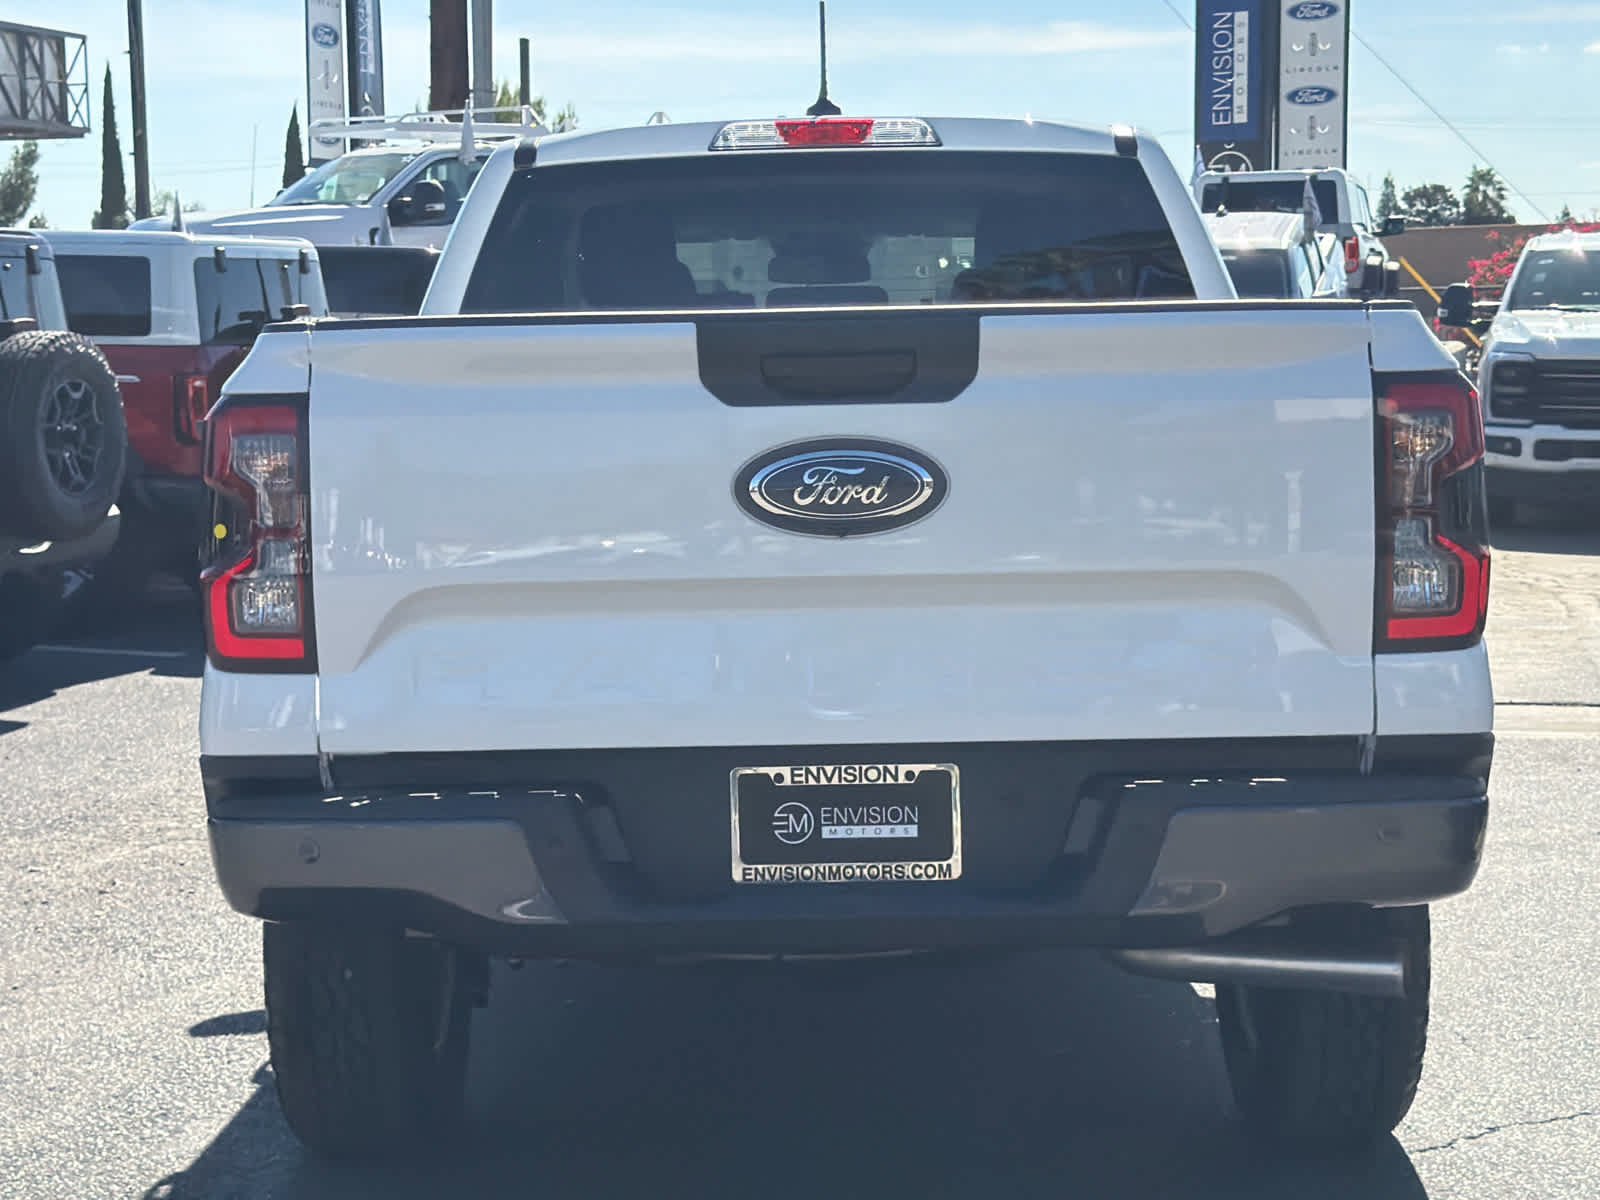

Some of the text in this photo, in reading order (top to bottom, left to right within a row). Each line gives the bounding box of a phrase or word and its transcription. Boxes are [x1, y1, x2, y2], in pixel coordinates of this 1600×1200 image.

[1296, 3, 1329, 18] Ford
[1212, 12, 1233, 125] ENVISION
[1236, 21, 1246, 115] MOTORS
[1295, 88, 1328, 102] Ford
[793, 466, 890, 506] Ford
[790, 765, 899, 784] ENVISION
[820, 805, 919, 825] ENVISION
[828, 827, 910, 836] MOTORS
[741, 863, 953, 882] ENVISIONMOTORS.COM
